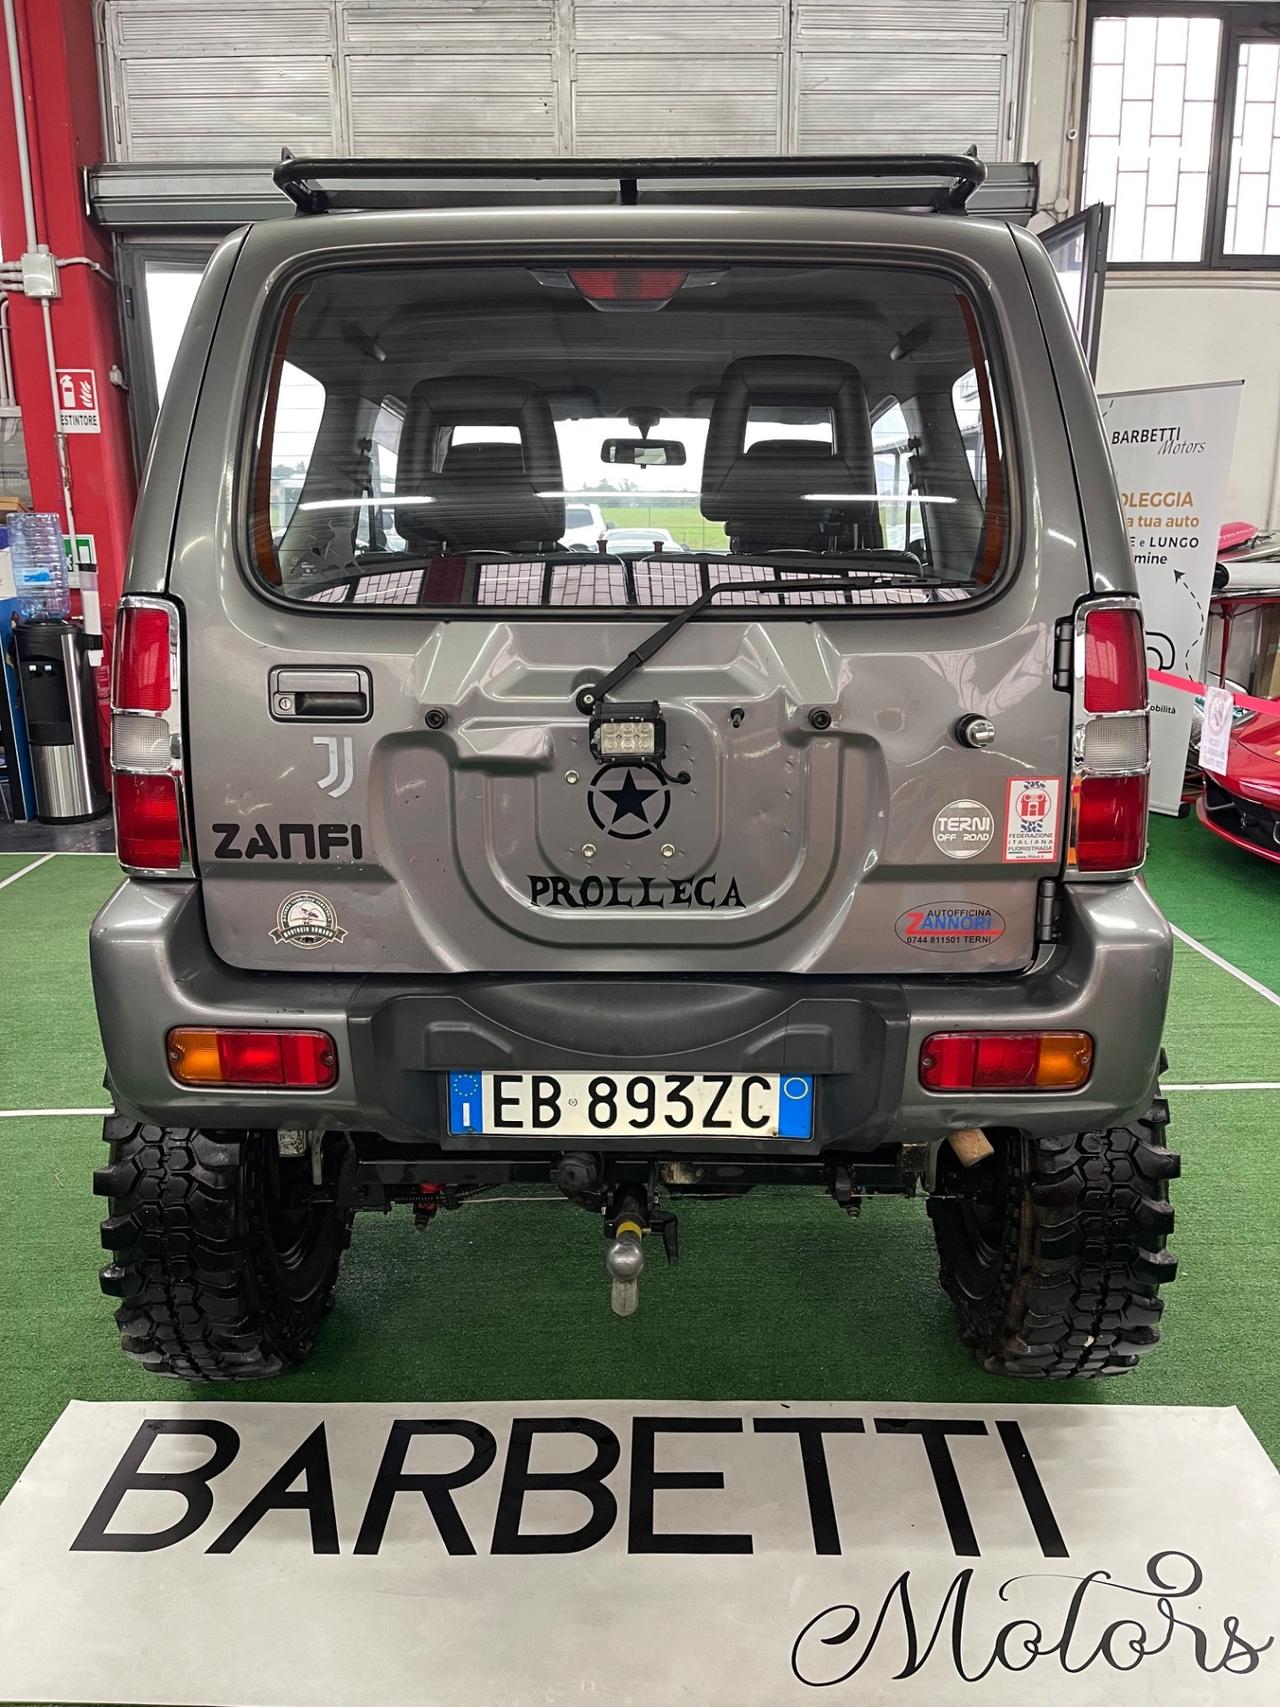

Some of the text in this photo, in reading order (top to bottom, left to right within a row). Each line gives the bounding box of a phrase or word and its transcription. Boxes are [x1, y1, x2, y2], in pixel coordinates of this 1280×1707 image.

[60, 414, 98, 426] ESTINTORE
[1111, 427, 1181, 445] BARBETTI
[1157, 439, 1206, 455] Motors
[1137, 514, 1162, 528] tua
[1165, 514, 1200, 528] auto
[1139, 539, 1146, 548] e
[1149, 536, 1200, 549] LUNGO
[938, 817, 991, 832] TERNI
[211, 823, 363, 860] ZANFI
[936, 833, 990, 842] OFF ROAD
[526, 872, 747, 911] PROLLECA
[927, 909, 992, 917] AUTOFFICINA
[905, 912, 993, 935] ZANNORI
[906, 935, 992, 944] 0744 811501 TERNI
[493, 1075, 562, 1129] EB
[588, 1075, 772, 1130] 893ZC
[68, 1417, 1071, 1557] BARBETTI
[791, 1550, 1276, 1688] Motors
